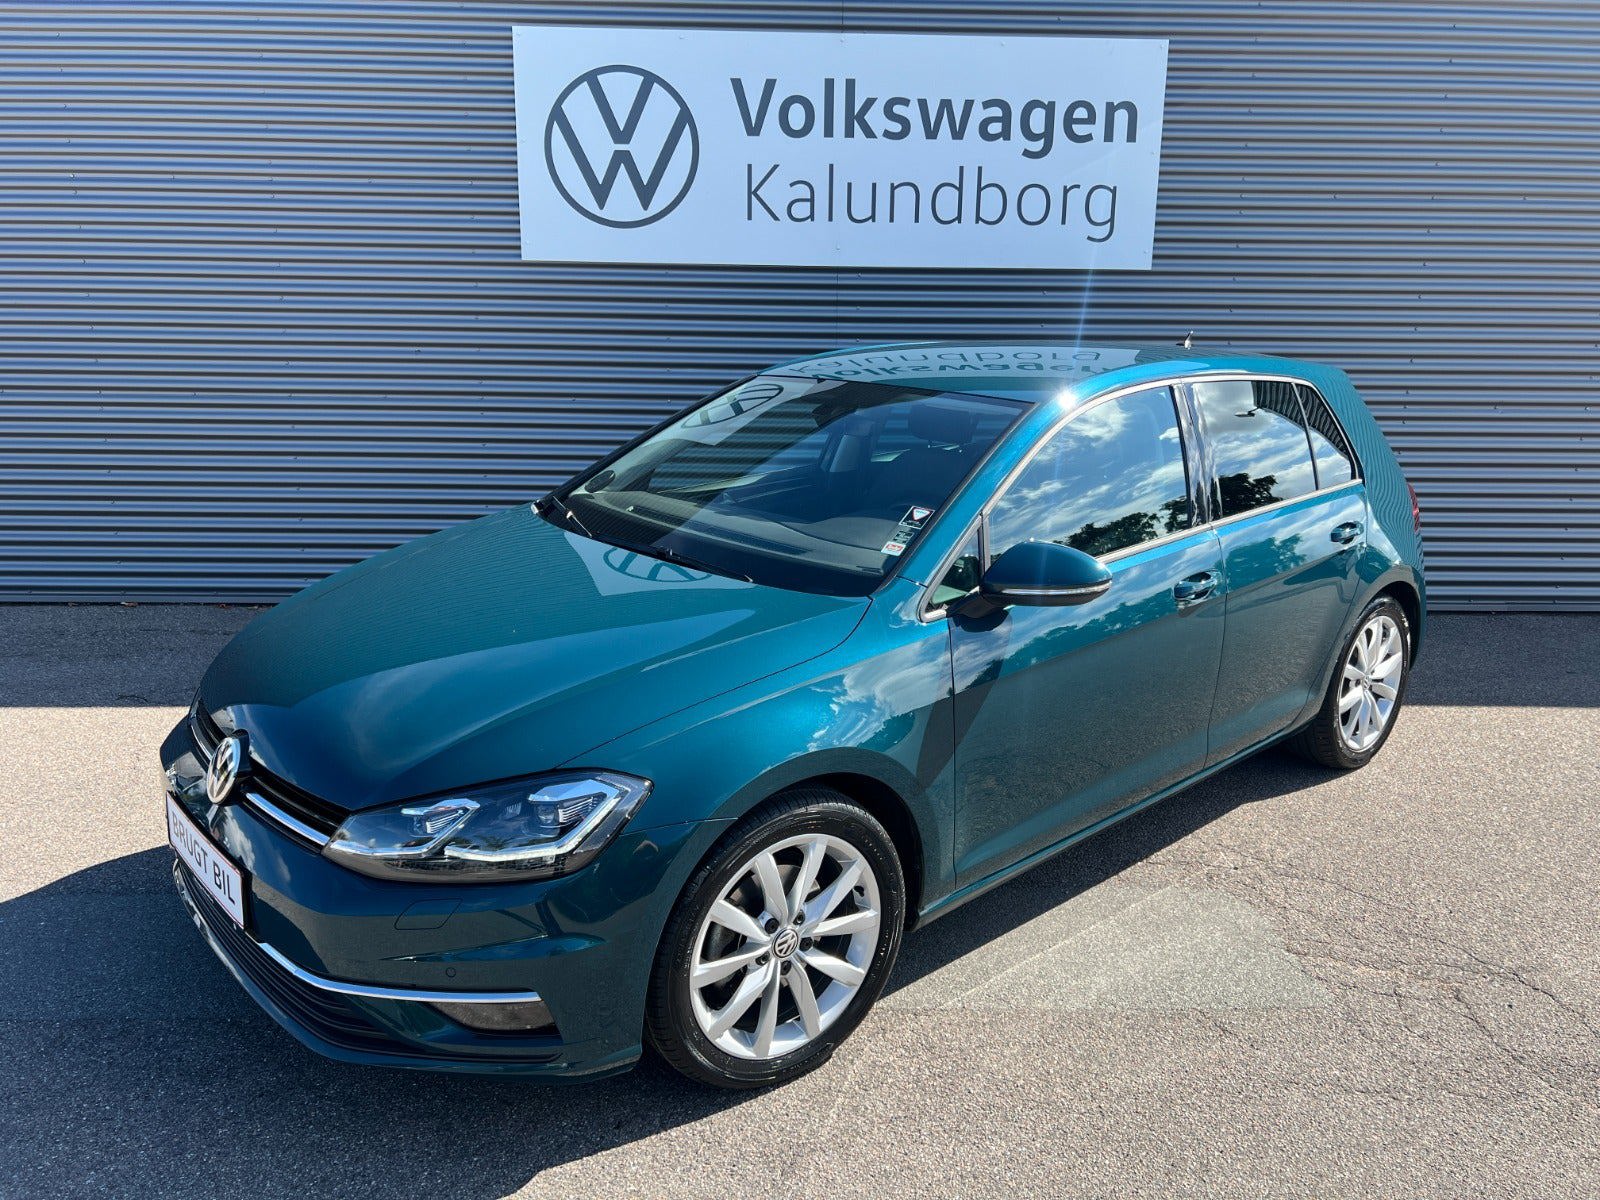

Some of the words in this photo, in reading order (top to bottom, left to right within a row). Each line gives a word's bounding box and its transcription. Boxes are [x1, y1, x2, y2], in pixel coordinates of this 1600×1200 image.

[545, 65, 699, 229] VW
[730, 78, 1137, 159] Volkswagen
[747, 164, 1116, 242] Kalundborg
[172, 811, 208, 874] BRUGT
[213, 860, 236, 906] BIL
